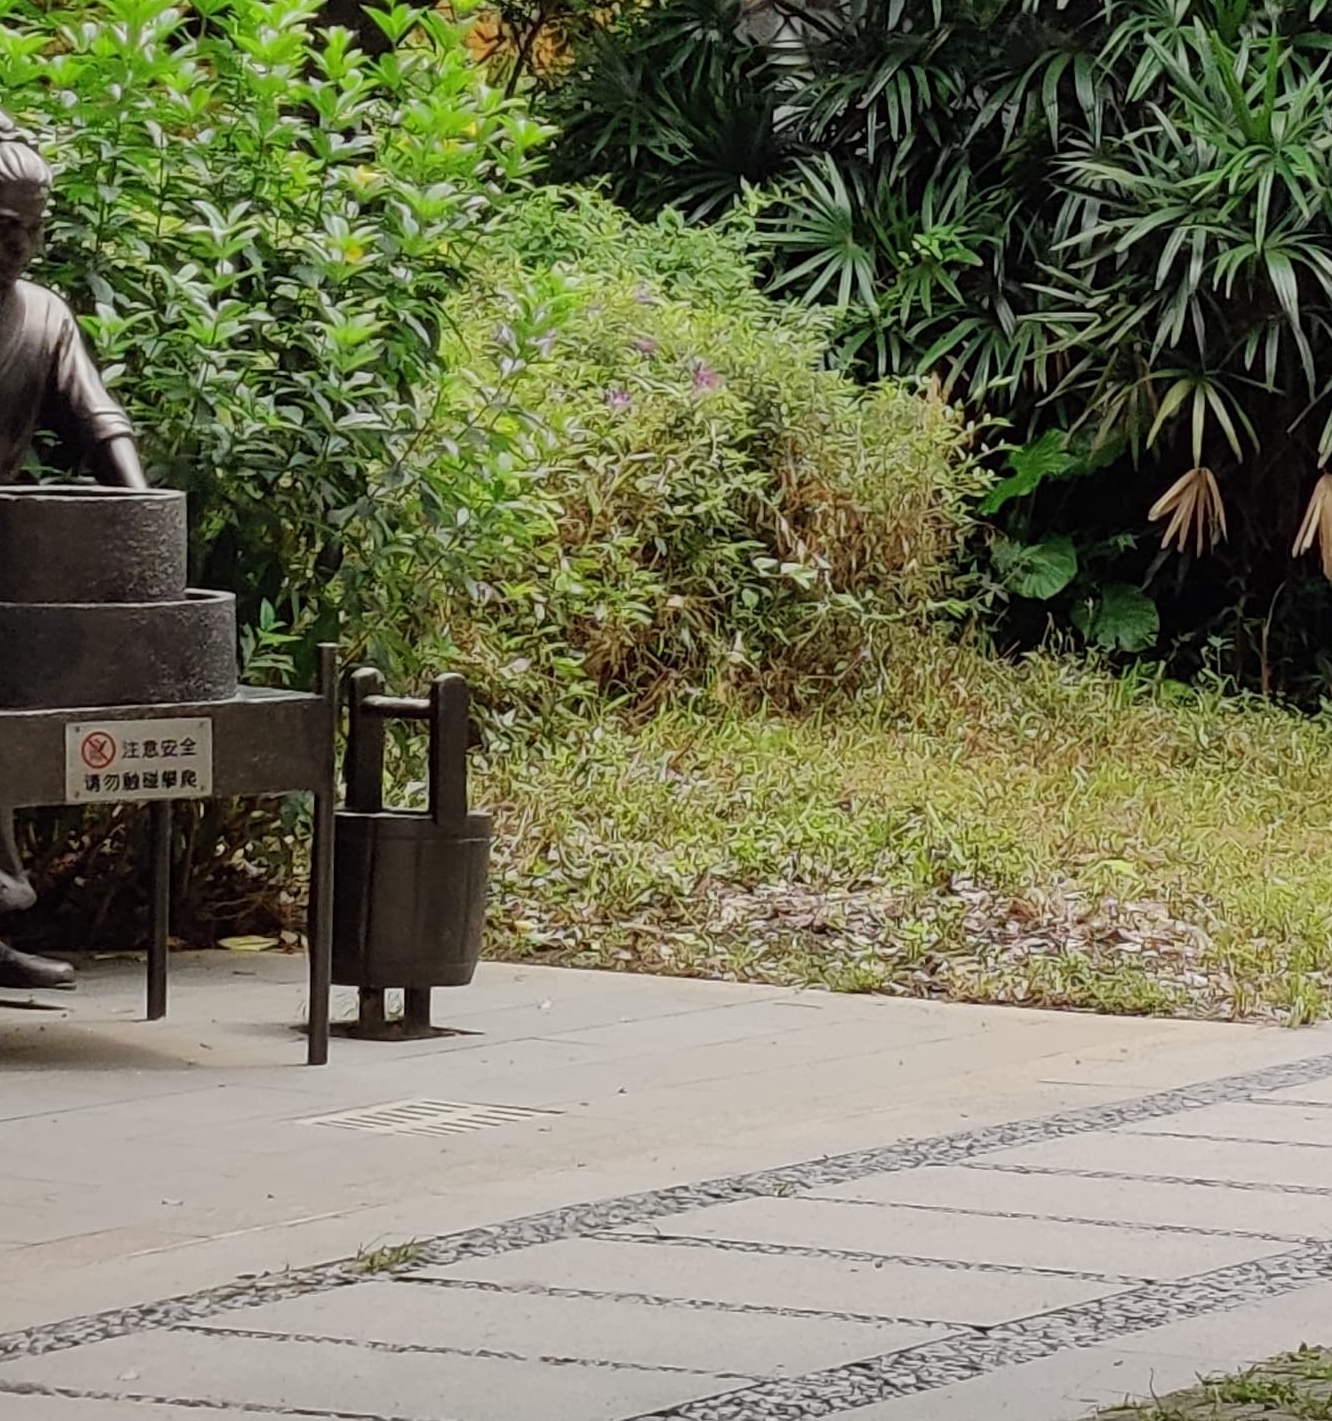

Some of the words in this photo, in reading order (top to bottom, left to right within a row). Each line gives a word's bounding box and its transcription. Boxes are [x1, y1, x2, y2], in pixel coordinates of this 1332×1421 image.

[122, 737, 197, 760] 注意安全
[84, 769, 198, 793] 请勿触碰攀爬
